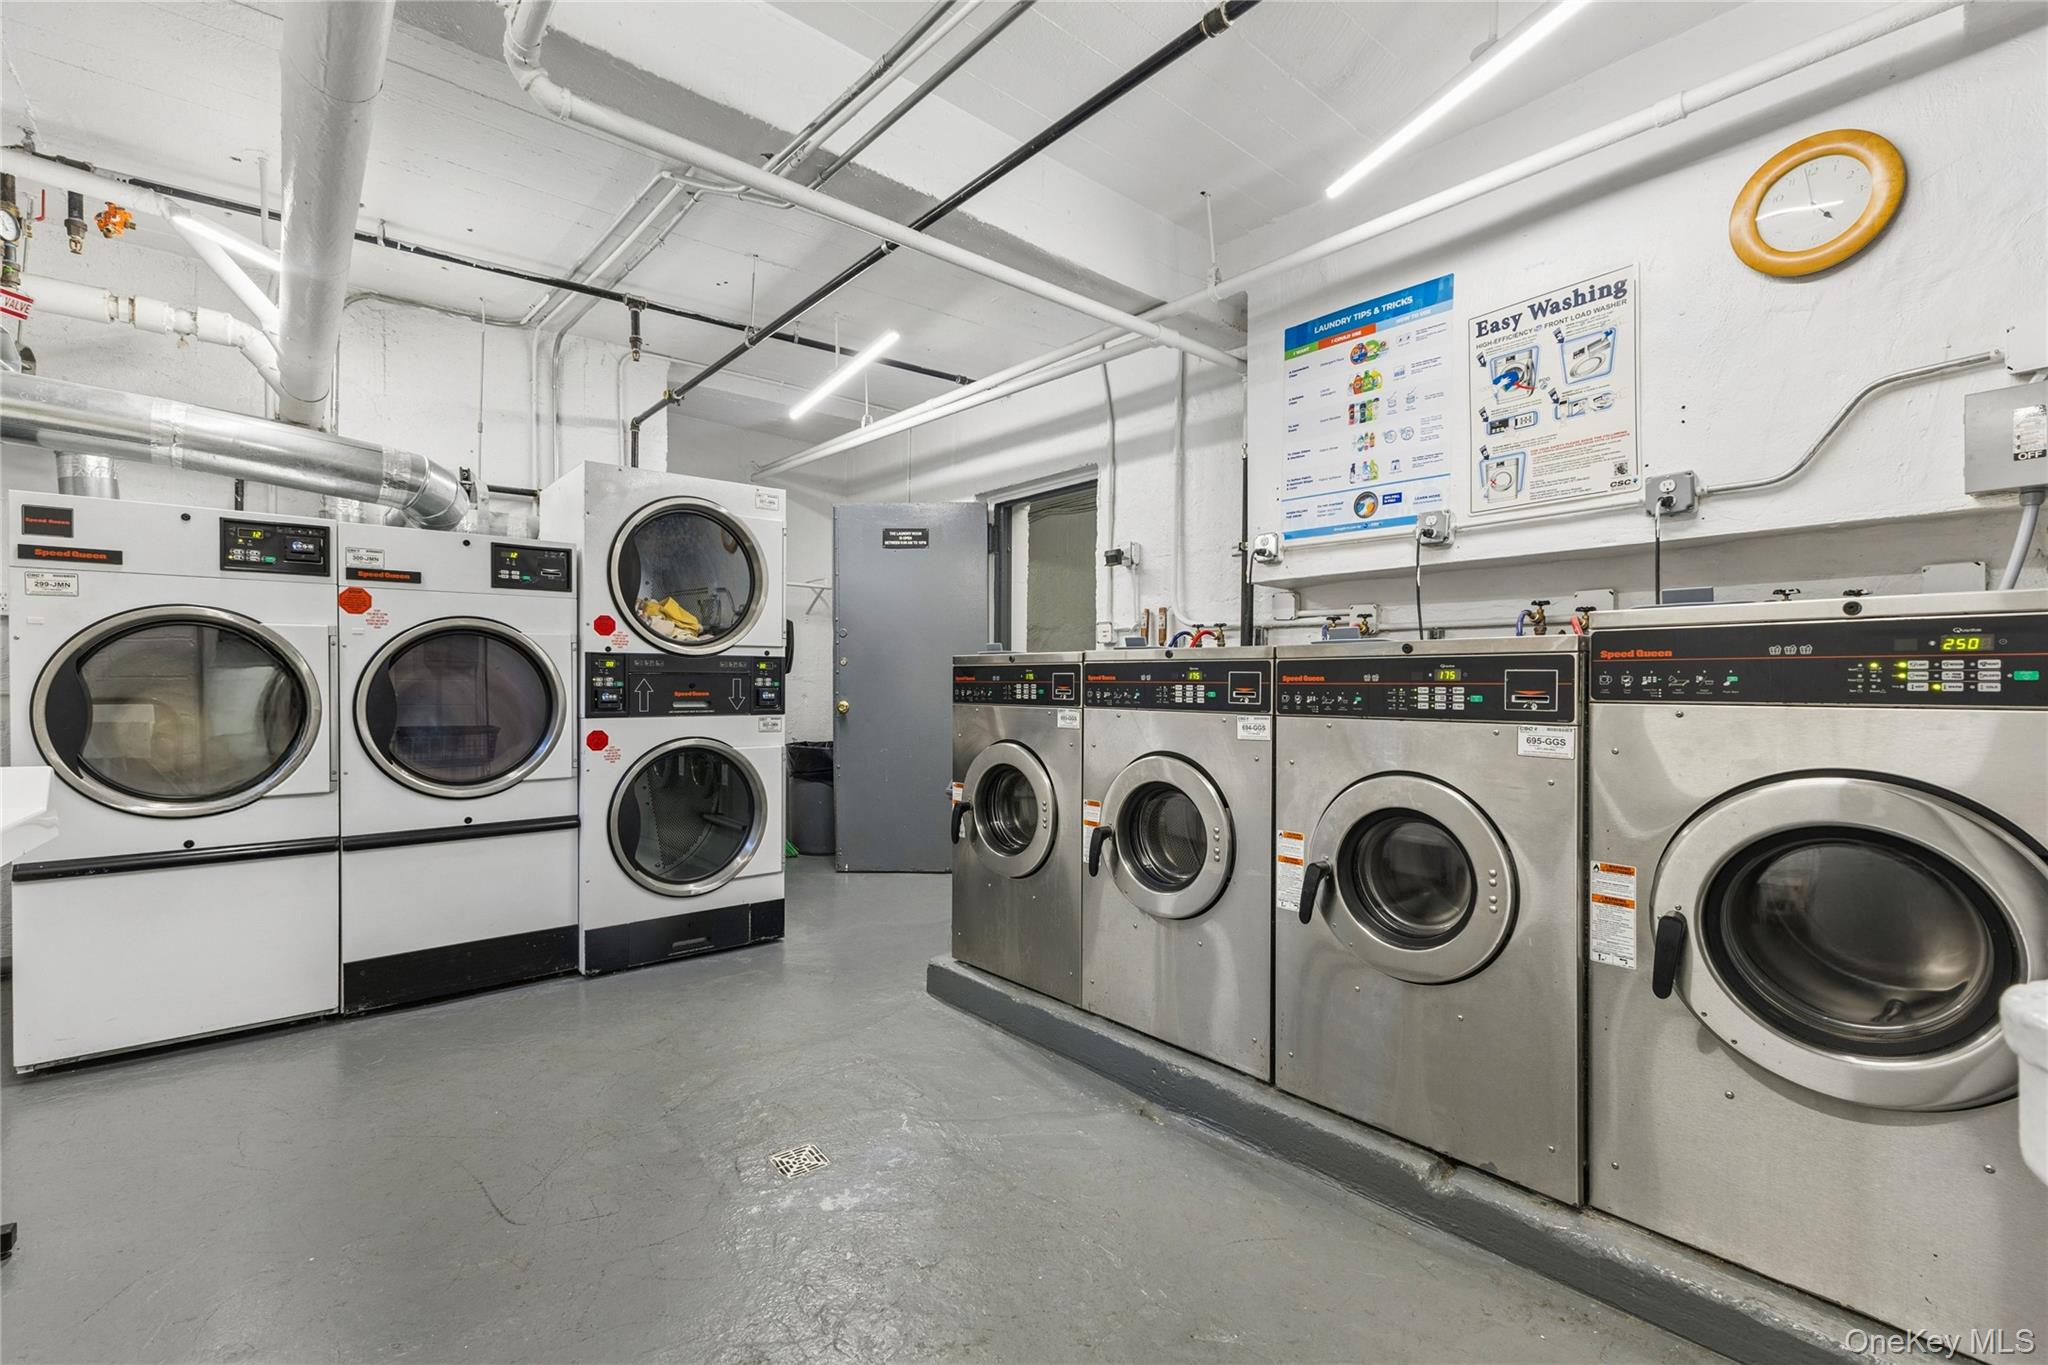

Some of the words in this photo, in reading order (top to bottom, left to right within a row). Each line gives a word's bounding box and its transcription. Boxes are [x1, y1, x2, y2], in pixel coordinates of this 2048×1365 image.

[4, 296, 31, 313] VALVE
[1476, 312, 1523, 338] Easy
[1528, 278, 1628, 320] Washing
[1314, 315, 1353, 335] LAUNDRY
[1353, 308, 1373, 321] TIPS
[1373, 307, 1380, 315] &
[1381, 295, 1414, 312] TRICKS
[1476, 328, 1533, 349] HIGH-EFFICIENCY
[1544, 318, 1569, 329] FRONT
[1570, 310, 1592, 321] LOAD
[1593, 299, 1628, 313] WASHER
[2018, 451, 2042, 460] OFF
[1610, 478, 1632, 488] CSC
[34, 548, 71, 557] Speed
[71, 550, 107, 560] Queen
[384, 572, 411, 580] Queen
[1943, 638, 1980, 650] 250
[1600, 649, 1635, 660] Speed
[1636, 649, 1673, 658] Queen
[1189, 672, 1200, 680] 175
[1440, 671, 1456, 680] 175
[1526, 737, 1567, 746] 695-GGS
